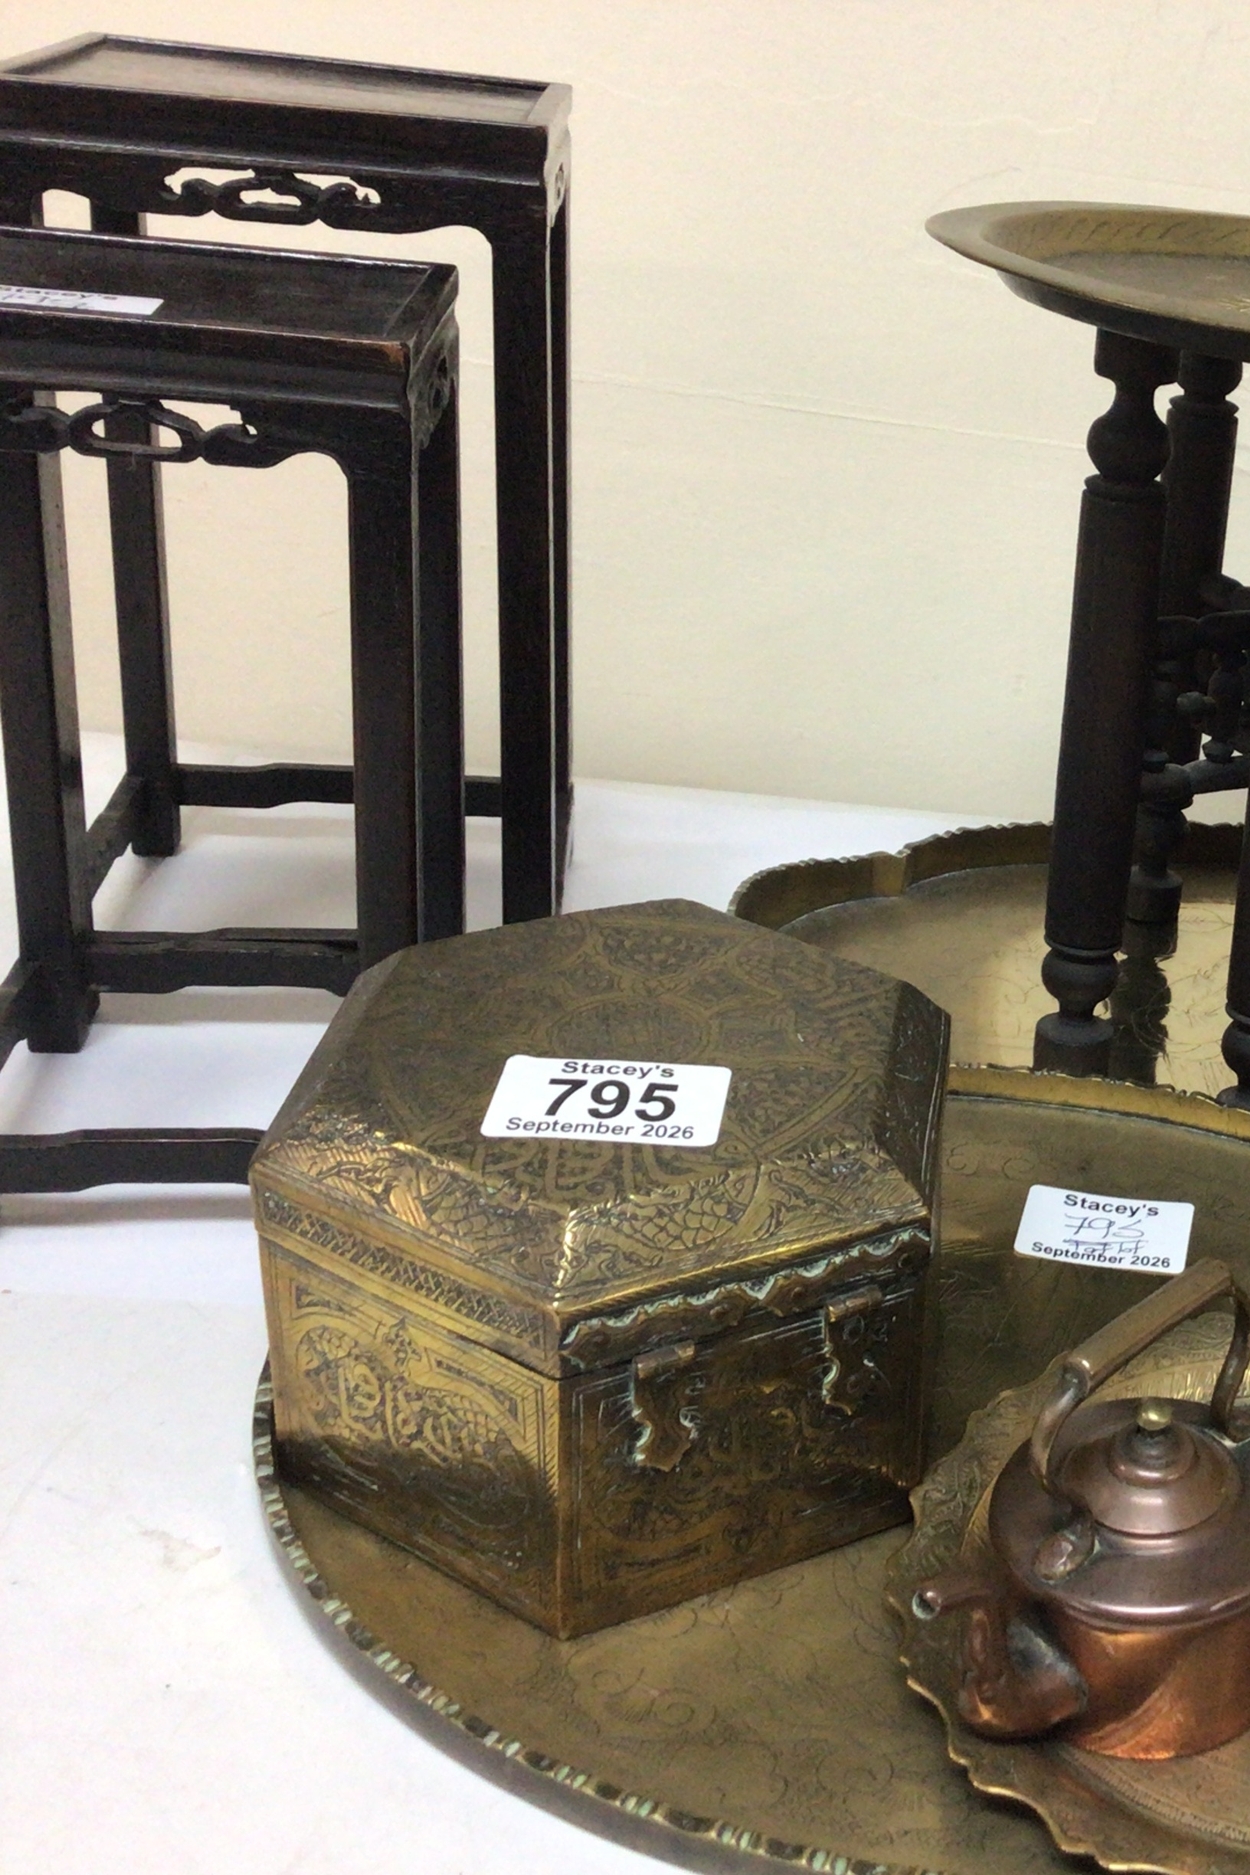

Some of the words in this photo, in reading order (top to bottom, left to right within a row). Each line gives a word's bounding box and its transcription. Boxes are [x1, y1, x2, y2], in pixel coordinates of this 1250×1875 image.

[561, 1061, 675, 1079] Stacey's
[544, 1078, 679, 1122] 795
[505, 1117, 634, 1136] September
[641, 1124, 694, 1139] 2026
[1064, 1193, 1159, 1217] Stacey's
[1031, 1241, 1125, 1264] September
[1130, 1255, 1170, 1268] 2026
